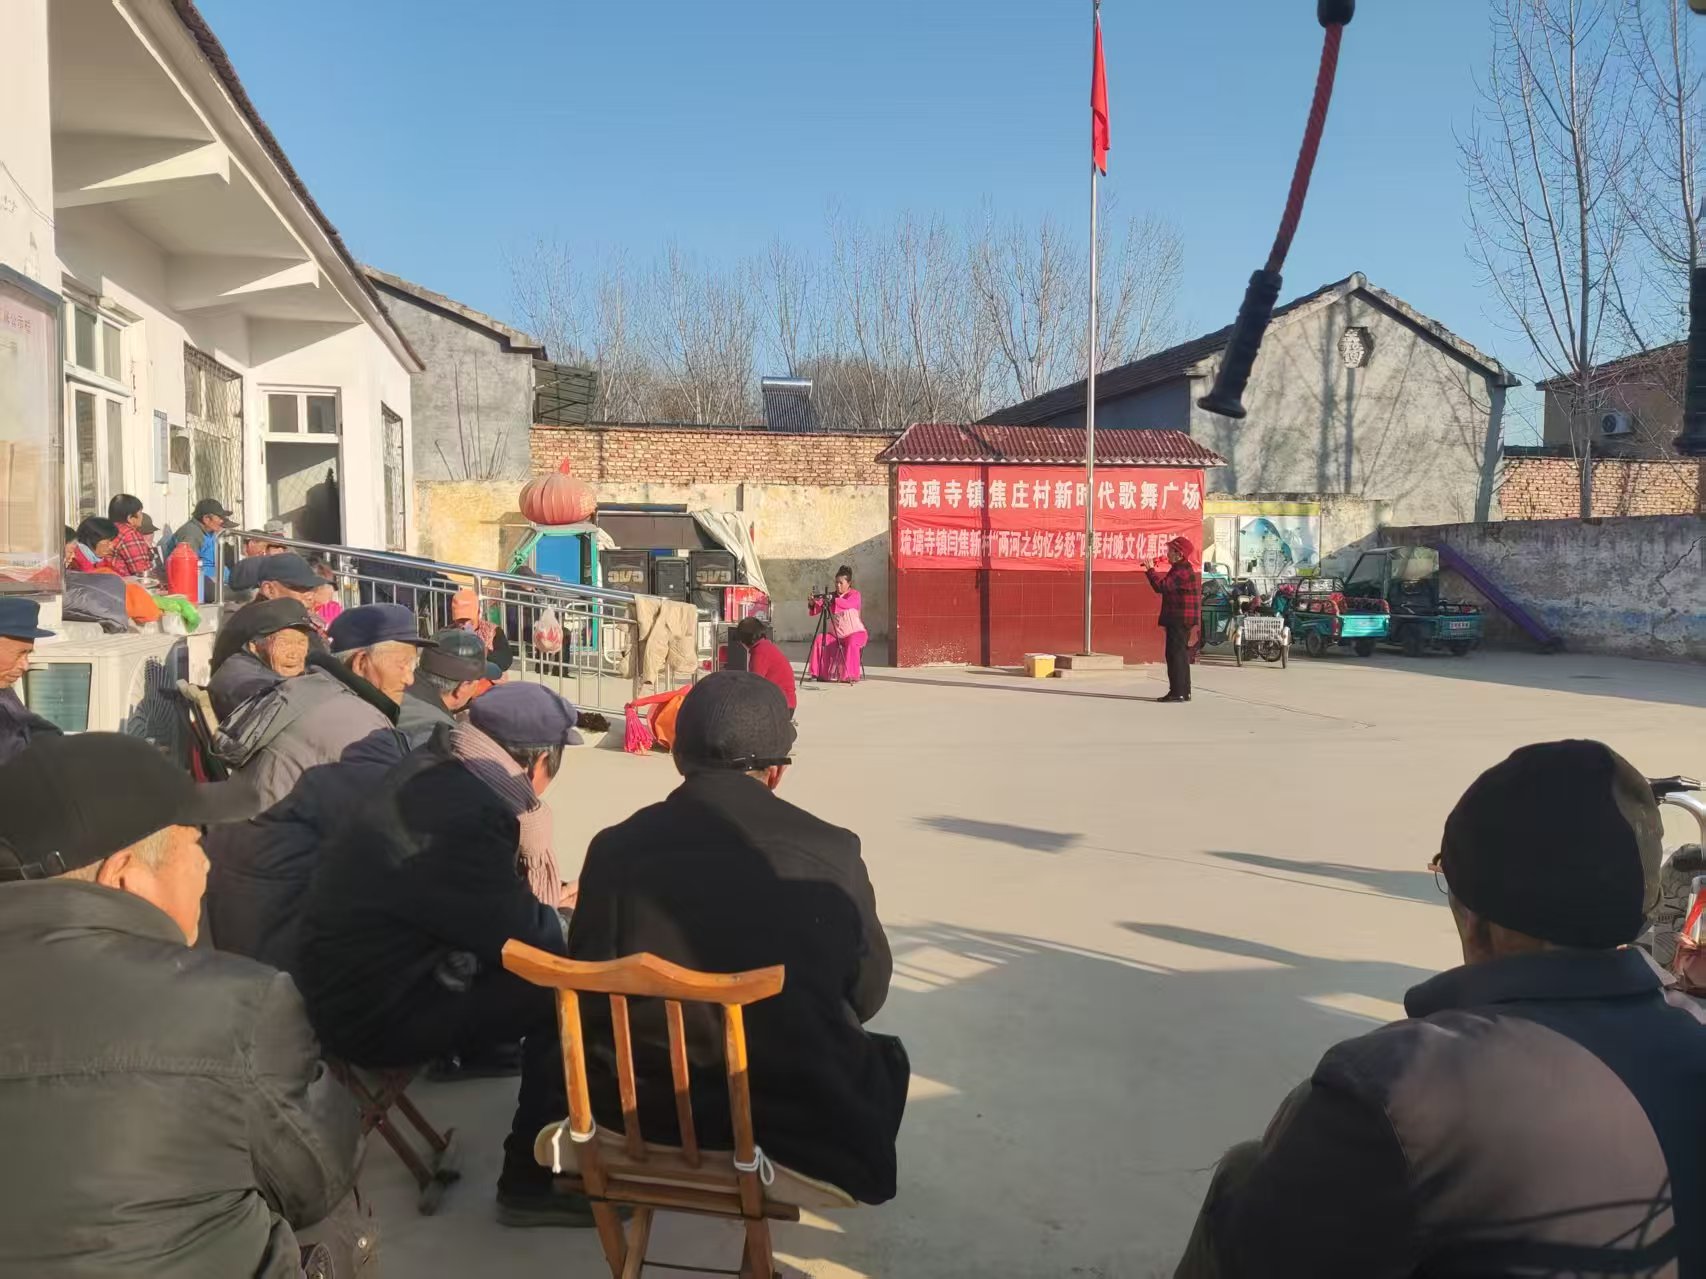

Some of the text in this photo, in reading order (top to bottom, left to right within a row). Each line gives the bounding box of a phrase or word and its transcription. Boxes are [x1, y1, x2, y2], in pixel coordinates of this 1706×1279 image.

[898, 479, 1201, 511] 琉璃寺镇焦庄村新时代歌舞广场
[899, 528, 1187, 560] 琉璃寺镇闫焦新村“两河之约忆乡愁”四季村晚文化惠民
